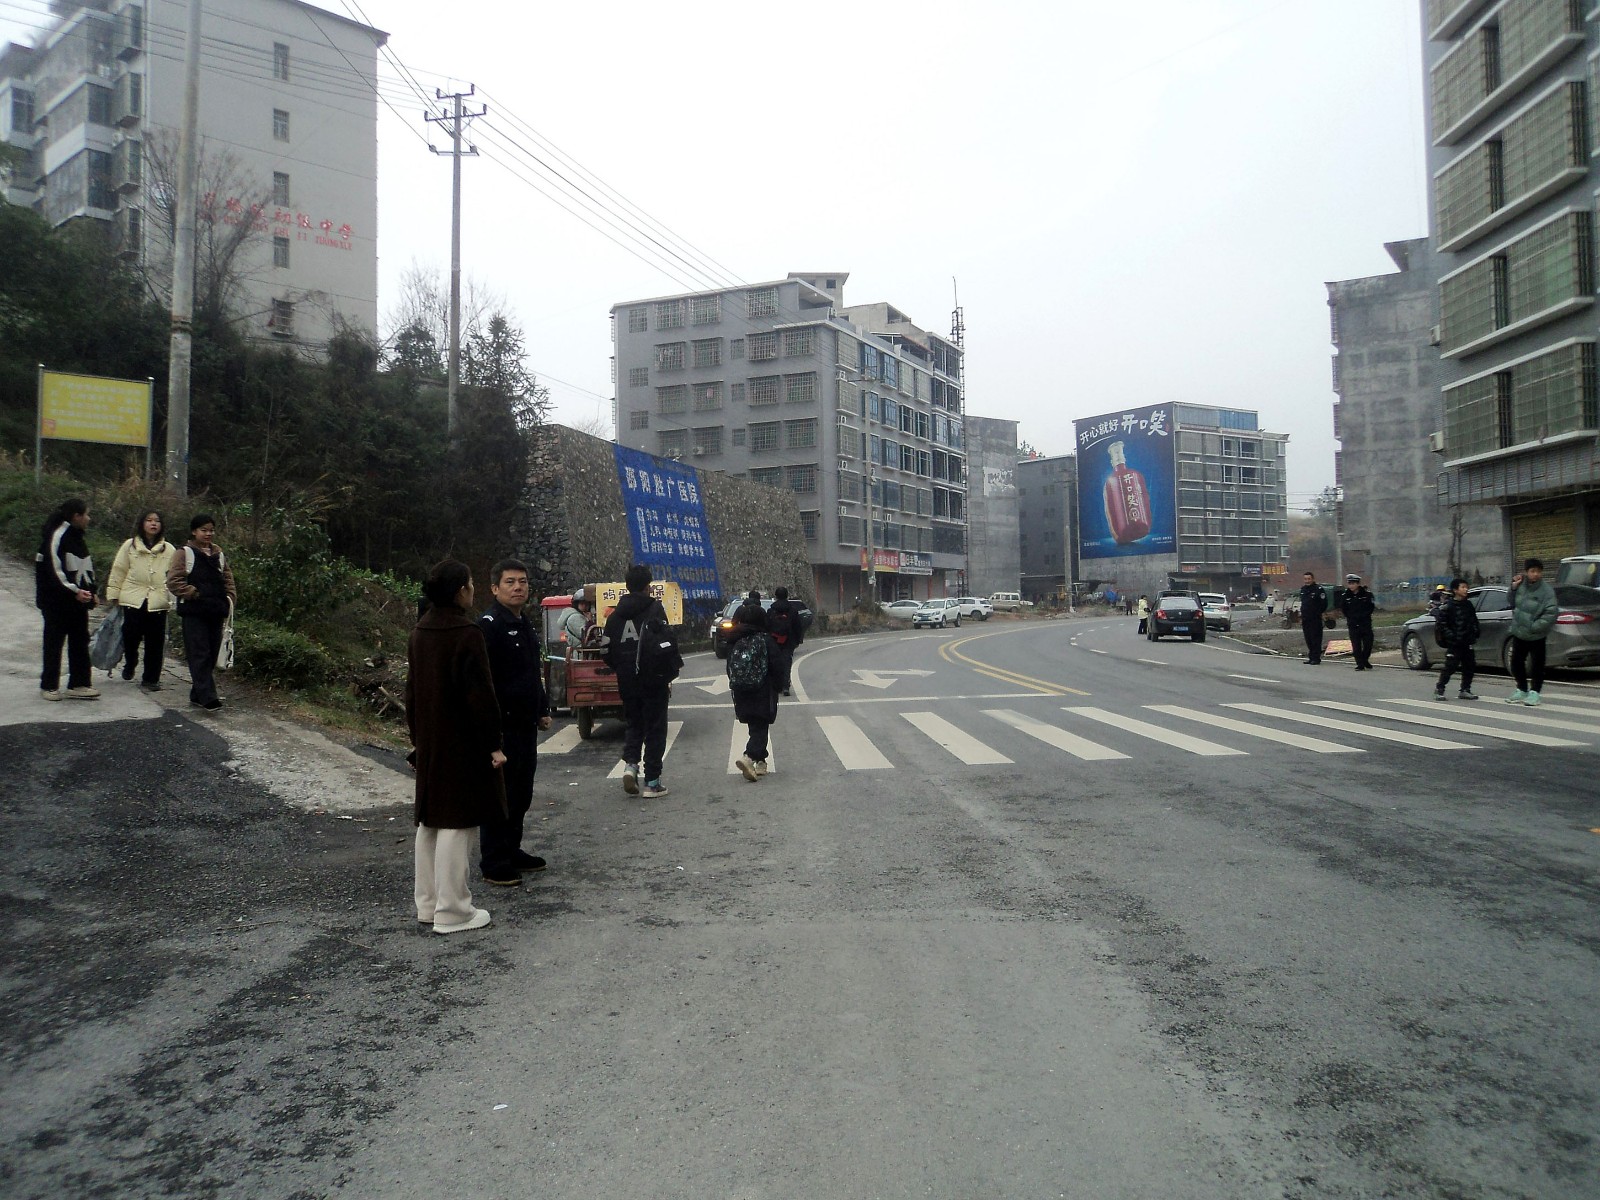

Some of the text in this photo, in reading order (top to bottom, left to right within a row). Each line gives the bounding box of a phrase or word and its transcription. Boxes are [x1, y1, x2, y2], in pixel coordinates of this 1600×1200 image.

[1079, 410, 1168, 445] 开心就好 开口笑
